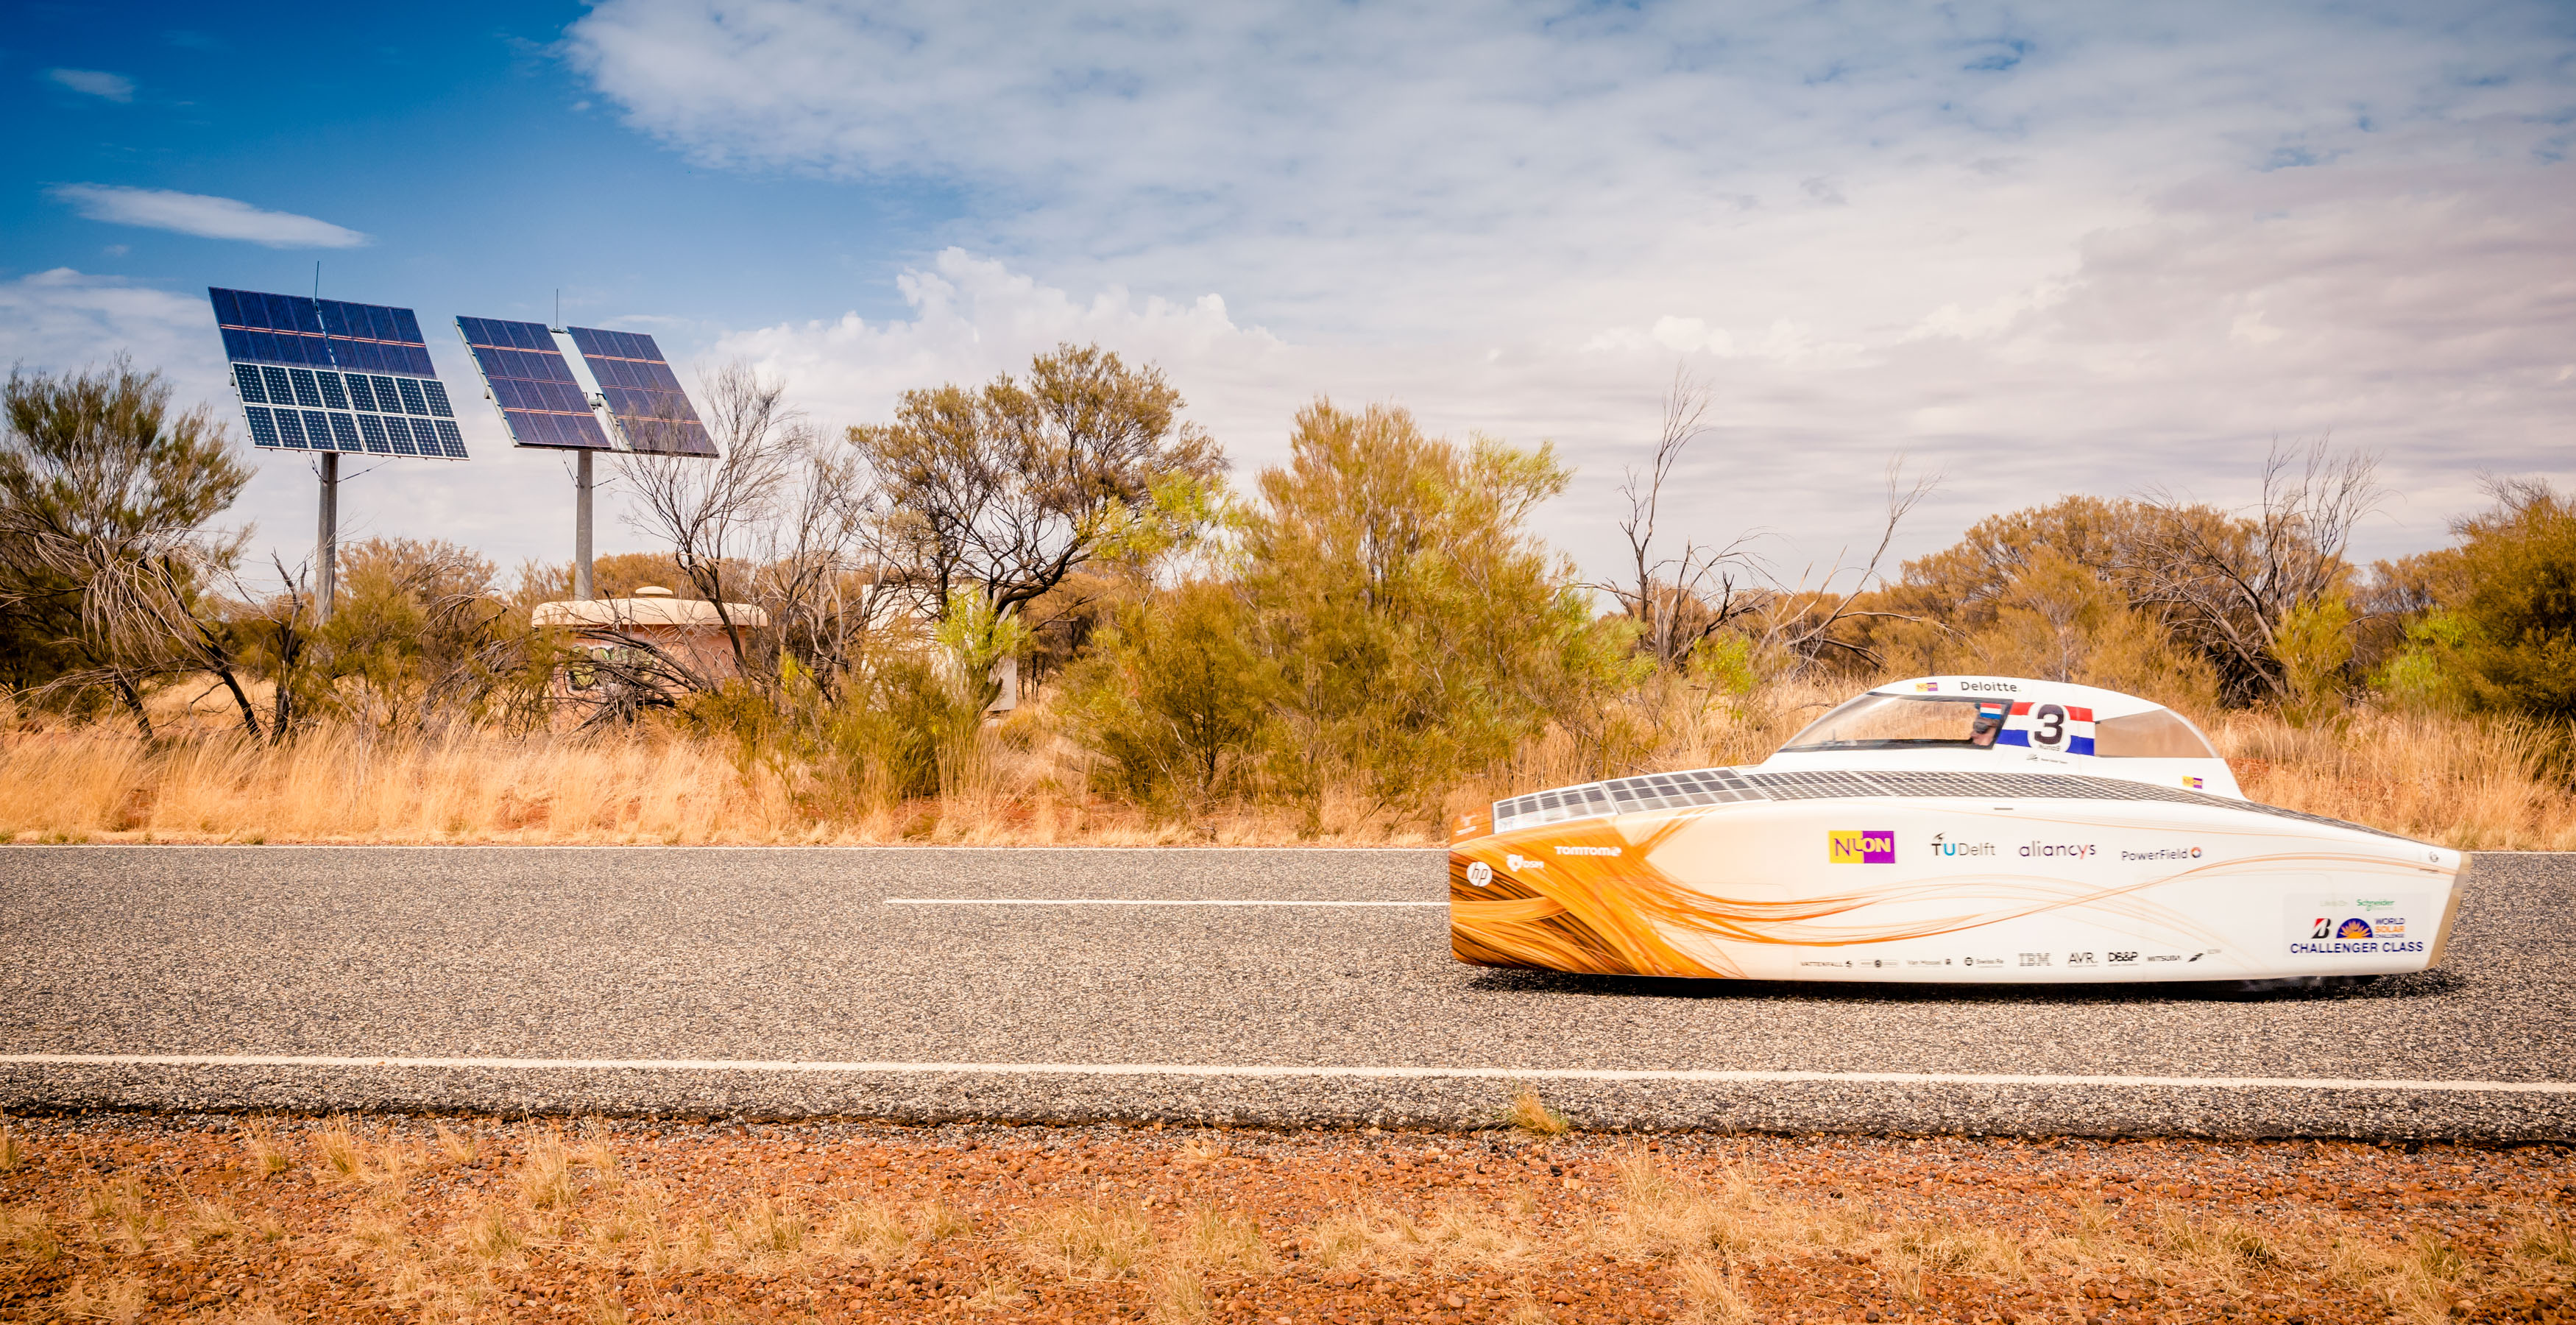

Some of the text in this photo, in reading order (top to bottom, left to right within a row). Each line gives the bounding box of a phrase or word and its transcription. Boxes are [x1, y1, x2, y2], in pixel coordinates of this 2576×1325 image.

[2034, 704, 2064, 745] 3
[1833, 837, 1891, 856] NUON
[2019, 841, 2096, 859] aliancys
[2121, 848, 2187, 861] PowerField
[1470, 862, 1490, 886] hp
[2290, 941, 2423, 953] CHALLENGER CLASS
[2019, 953, 2052, 966] IBM
